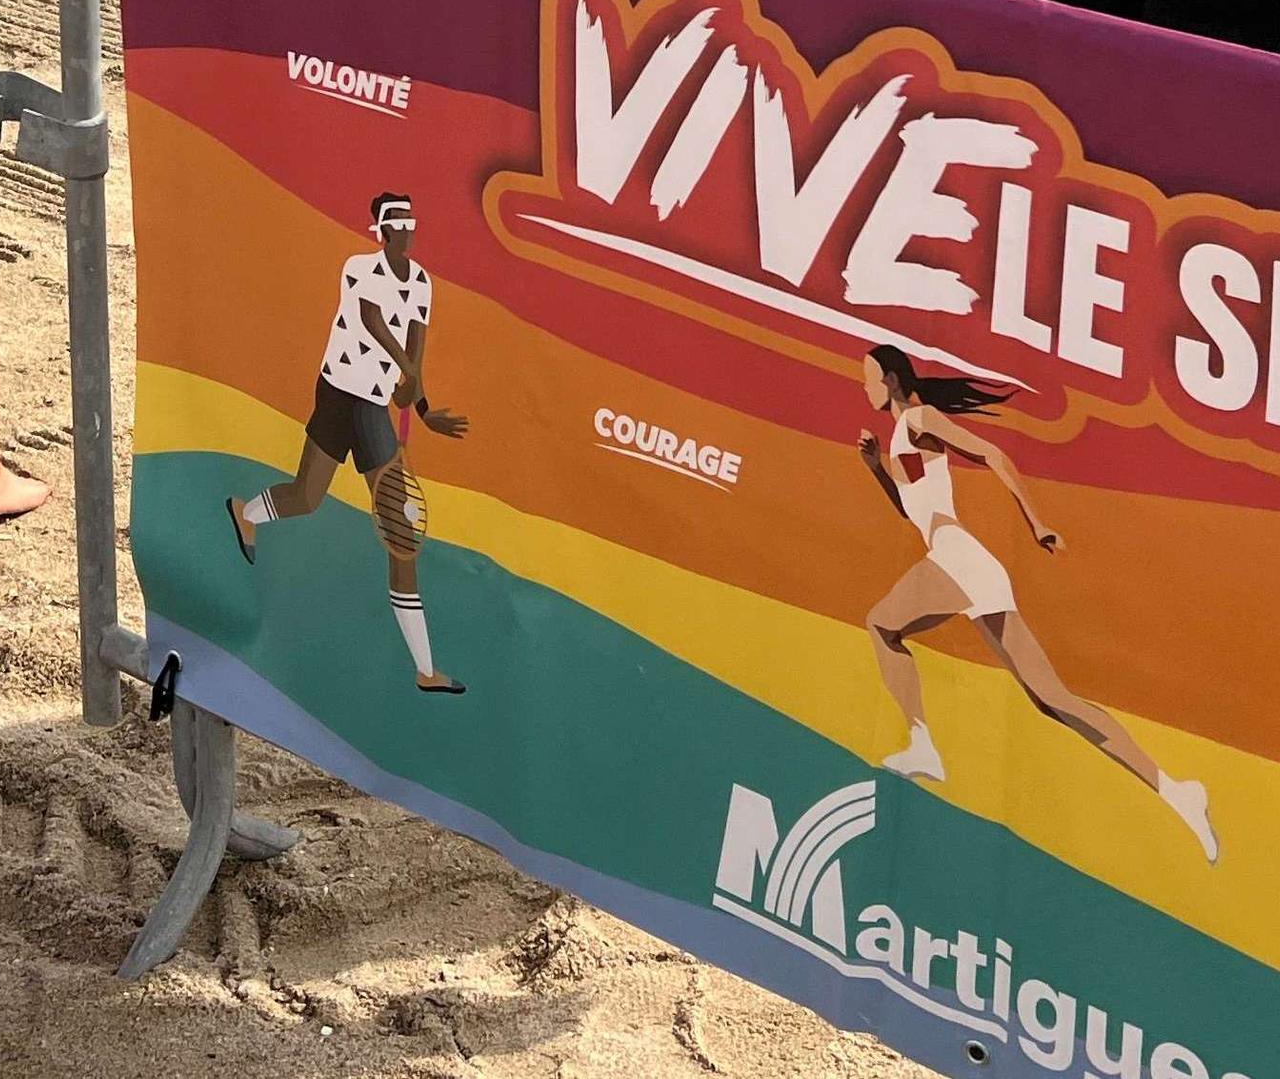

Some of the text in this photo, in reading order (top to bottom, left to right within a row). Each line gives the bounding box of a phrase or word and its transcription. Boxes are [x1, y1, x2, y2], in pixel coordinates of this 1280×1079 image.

[287, 51, 412, 109] VOLONTÉ
[991, 181, 1131, 379] LE
[593, 408, 742, 483] COURAGE
[715, 779, 1252, 1079] Martigue
